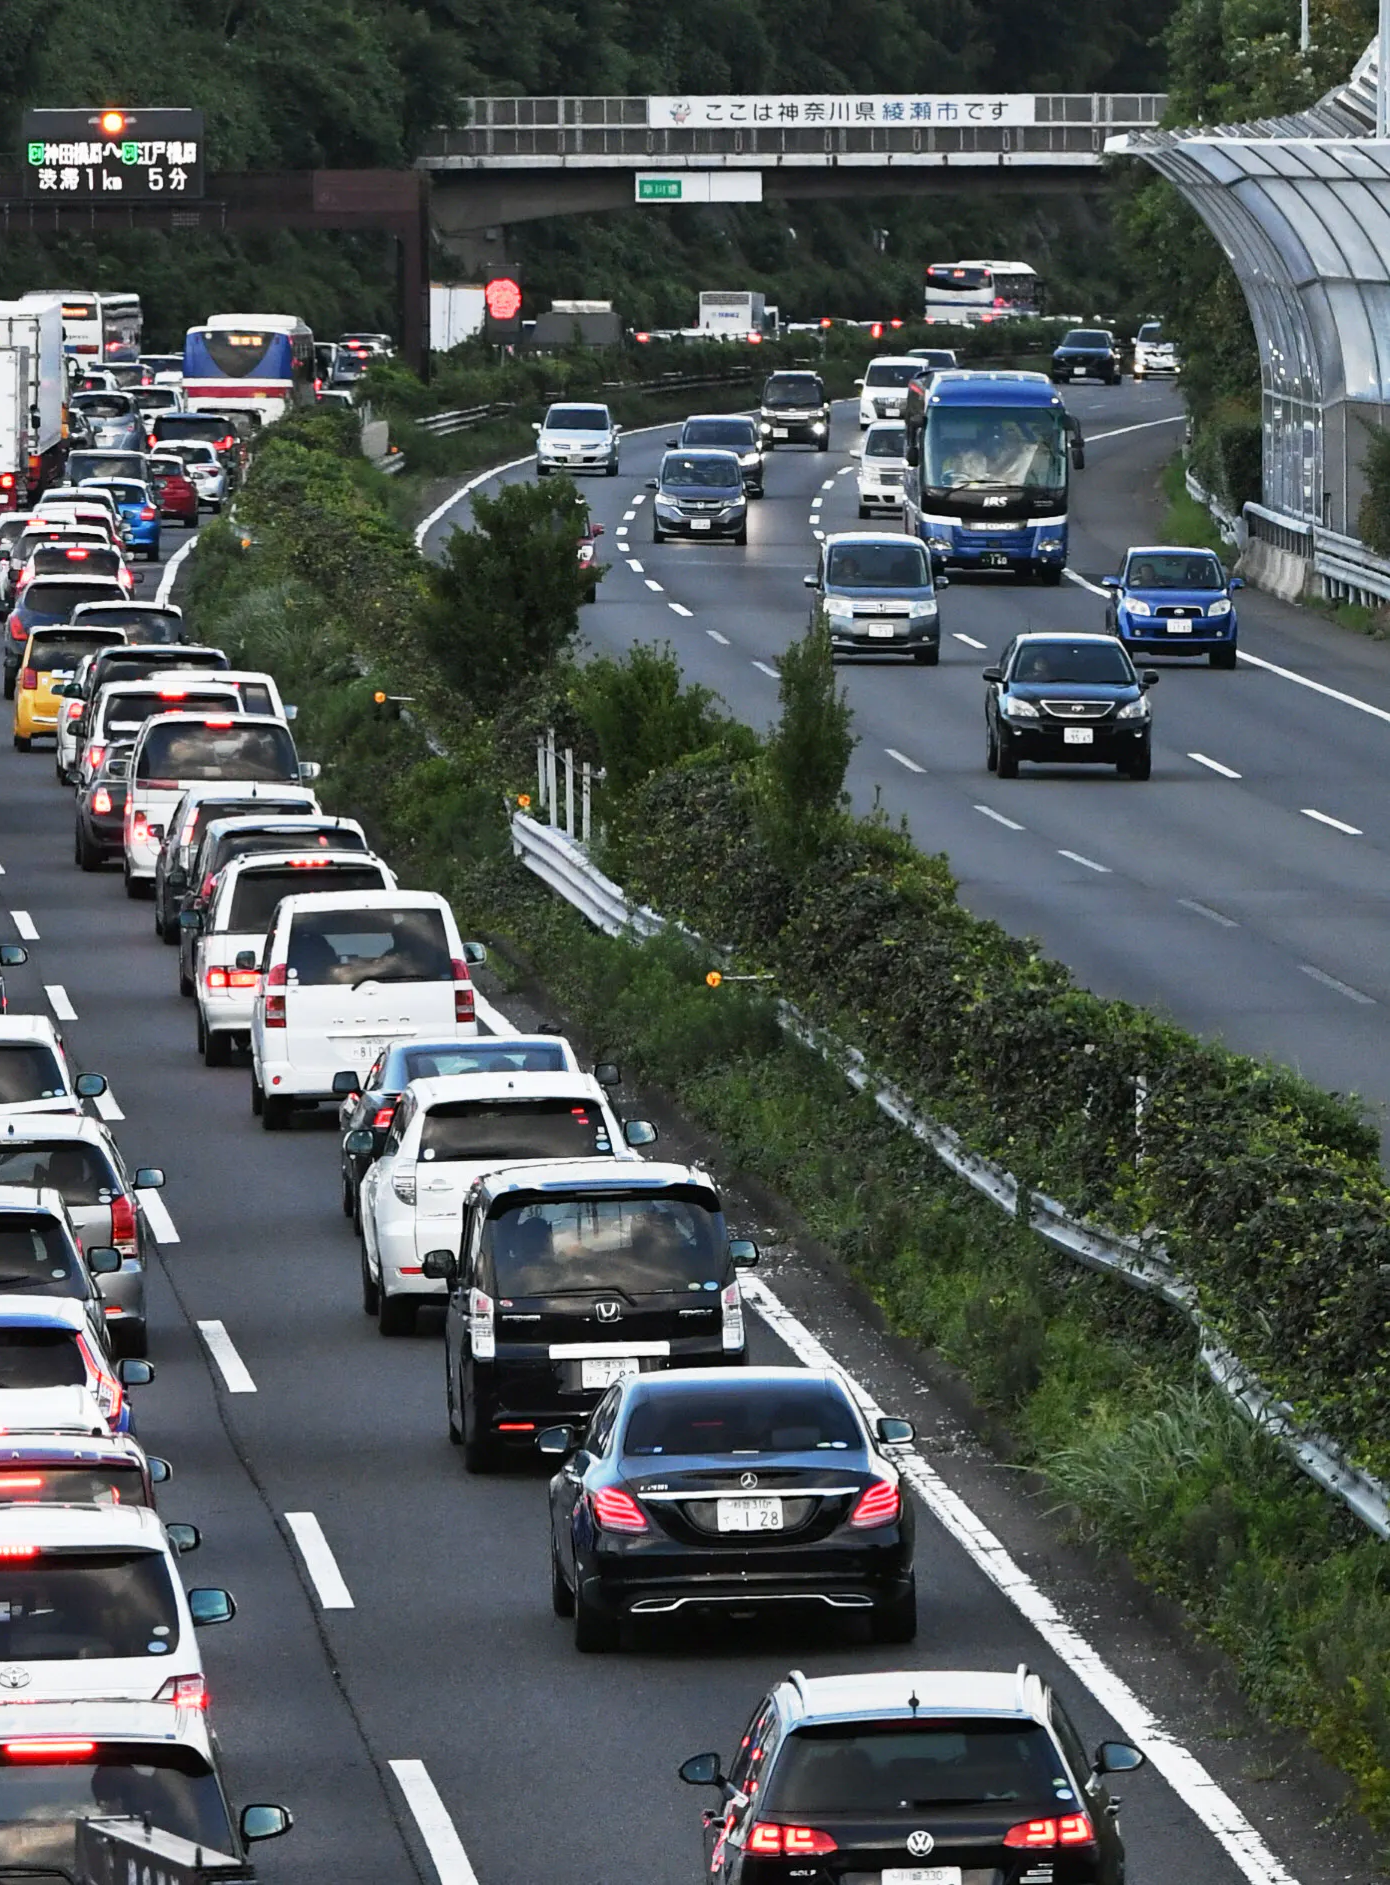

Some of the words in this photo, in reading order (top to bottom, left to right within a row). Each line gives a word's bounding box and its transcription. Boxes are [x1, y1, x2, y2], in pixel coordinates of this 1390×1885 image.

[705, 101, 1009, 122] ここは神奈川県綾瀬市です
